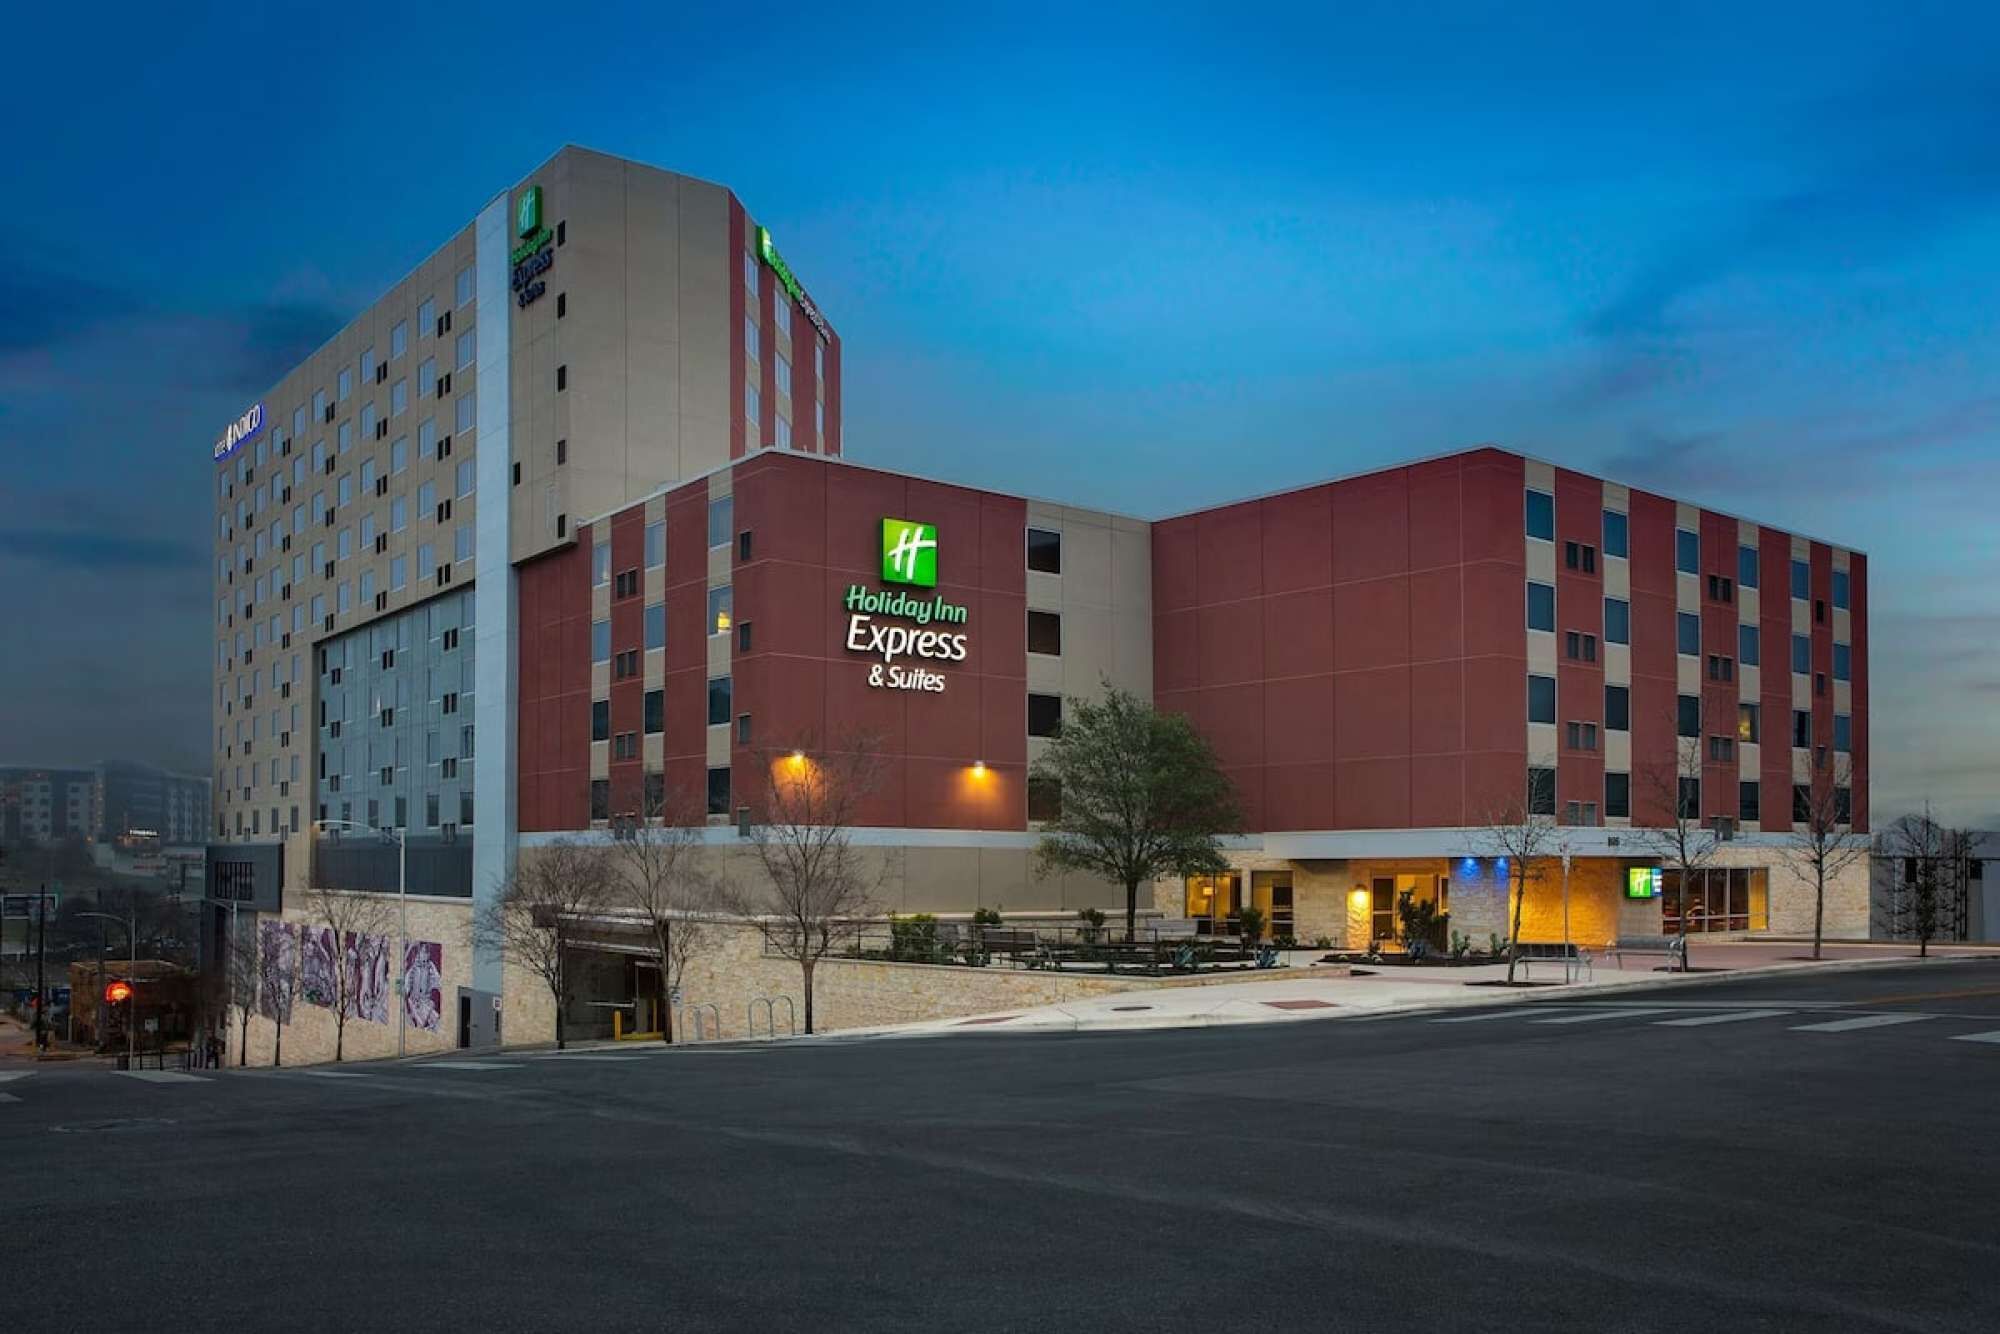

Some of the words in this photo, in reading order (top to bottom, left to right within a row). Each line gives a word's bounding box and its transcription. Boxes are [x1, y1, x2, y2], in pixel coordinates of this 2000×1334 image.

[847, 585, 931, 624] Holiday
[934, 596, 967, 624] Inn
[847, 614, 967, 663] Express
[868, 663, 883, 687] &
[887, 665, 946, 693] Suites
